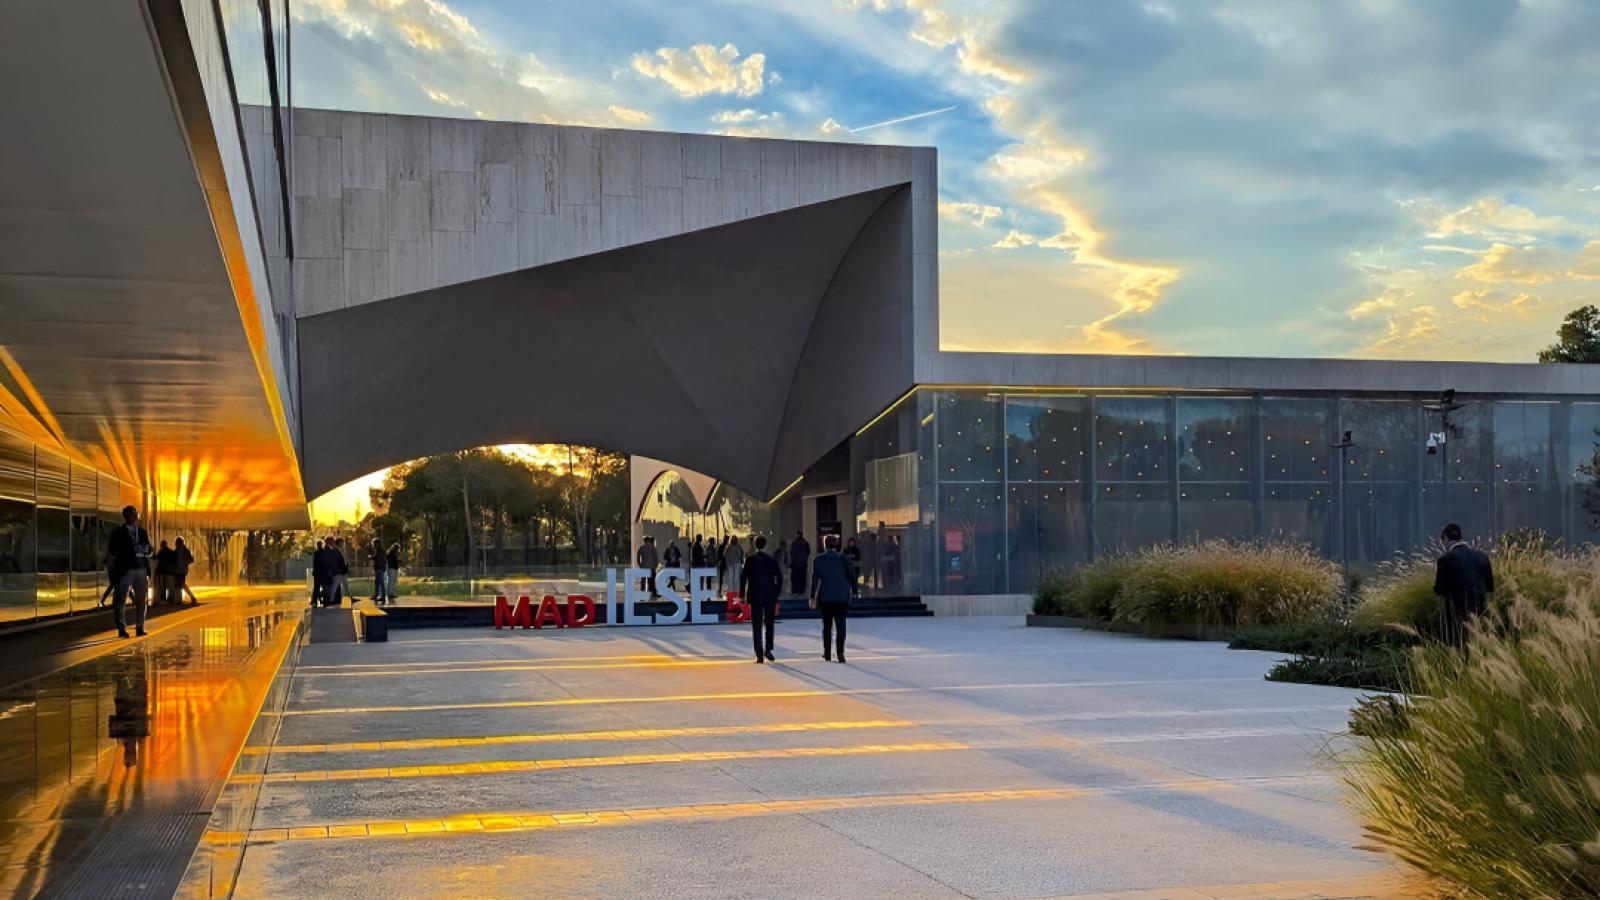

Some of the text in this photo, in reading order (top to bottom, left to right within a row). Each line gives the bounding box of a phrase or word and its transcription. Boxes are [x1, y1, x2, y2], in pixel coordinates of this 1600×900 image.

[495, 568, 754, 629] MAD IESE 5
